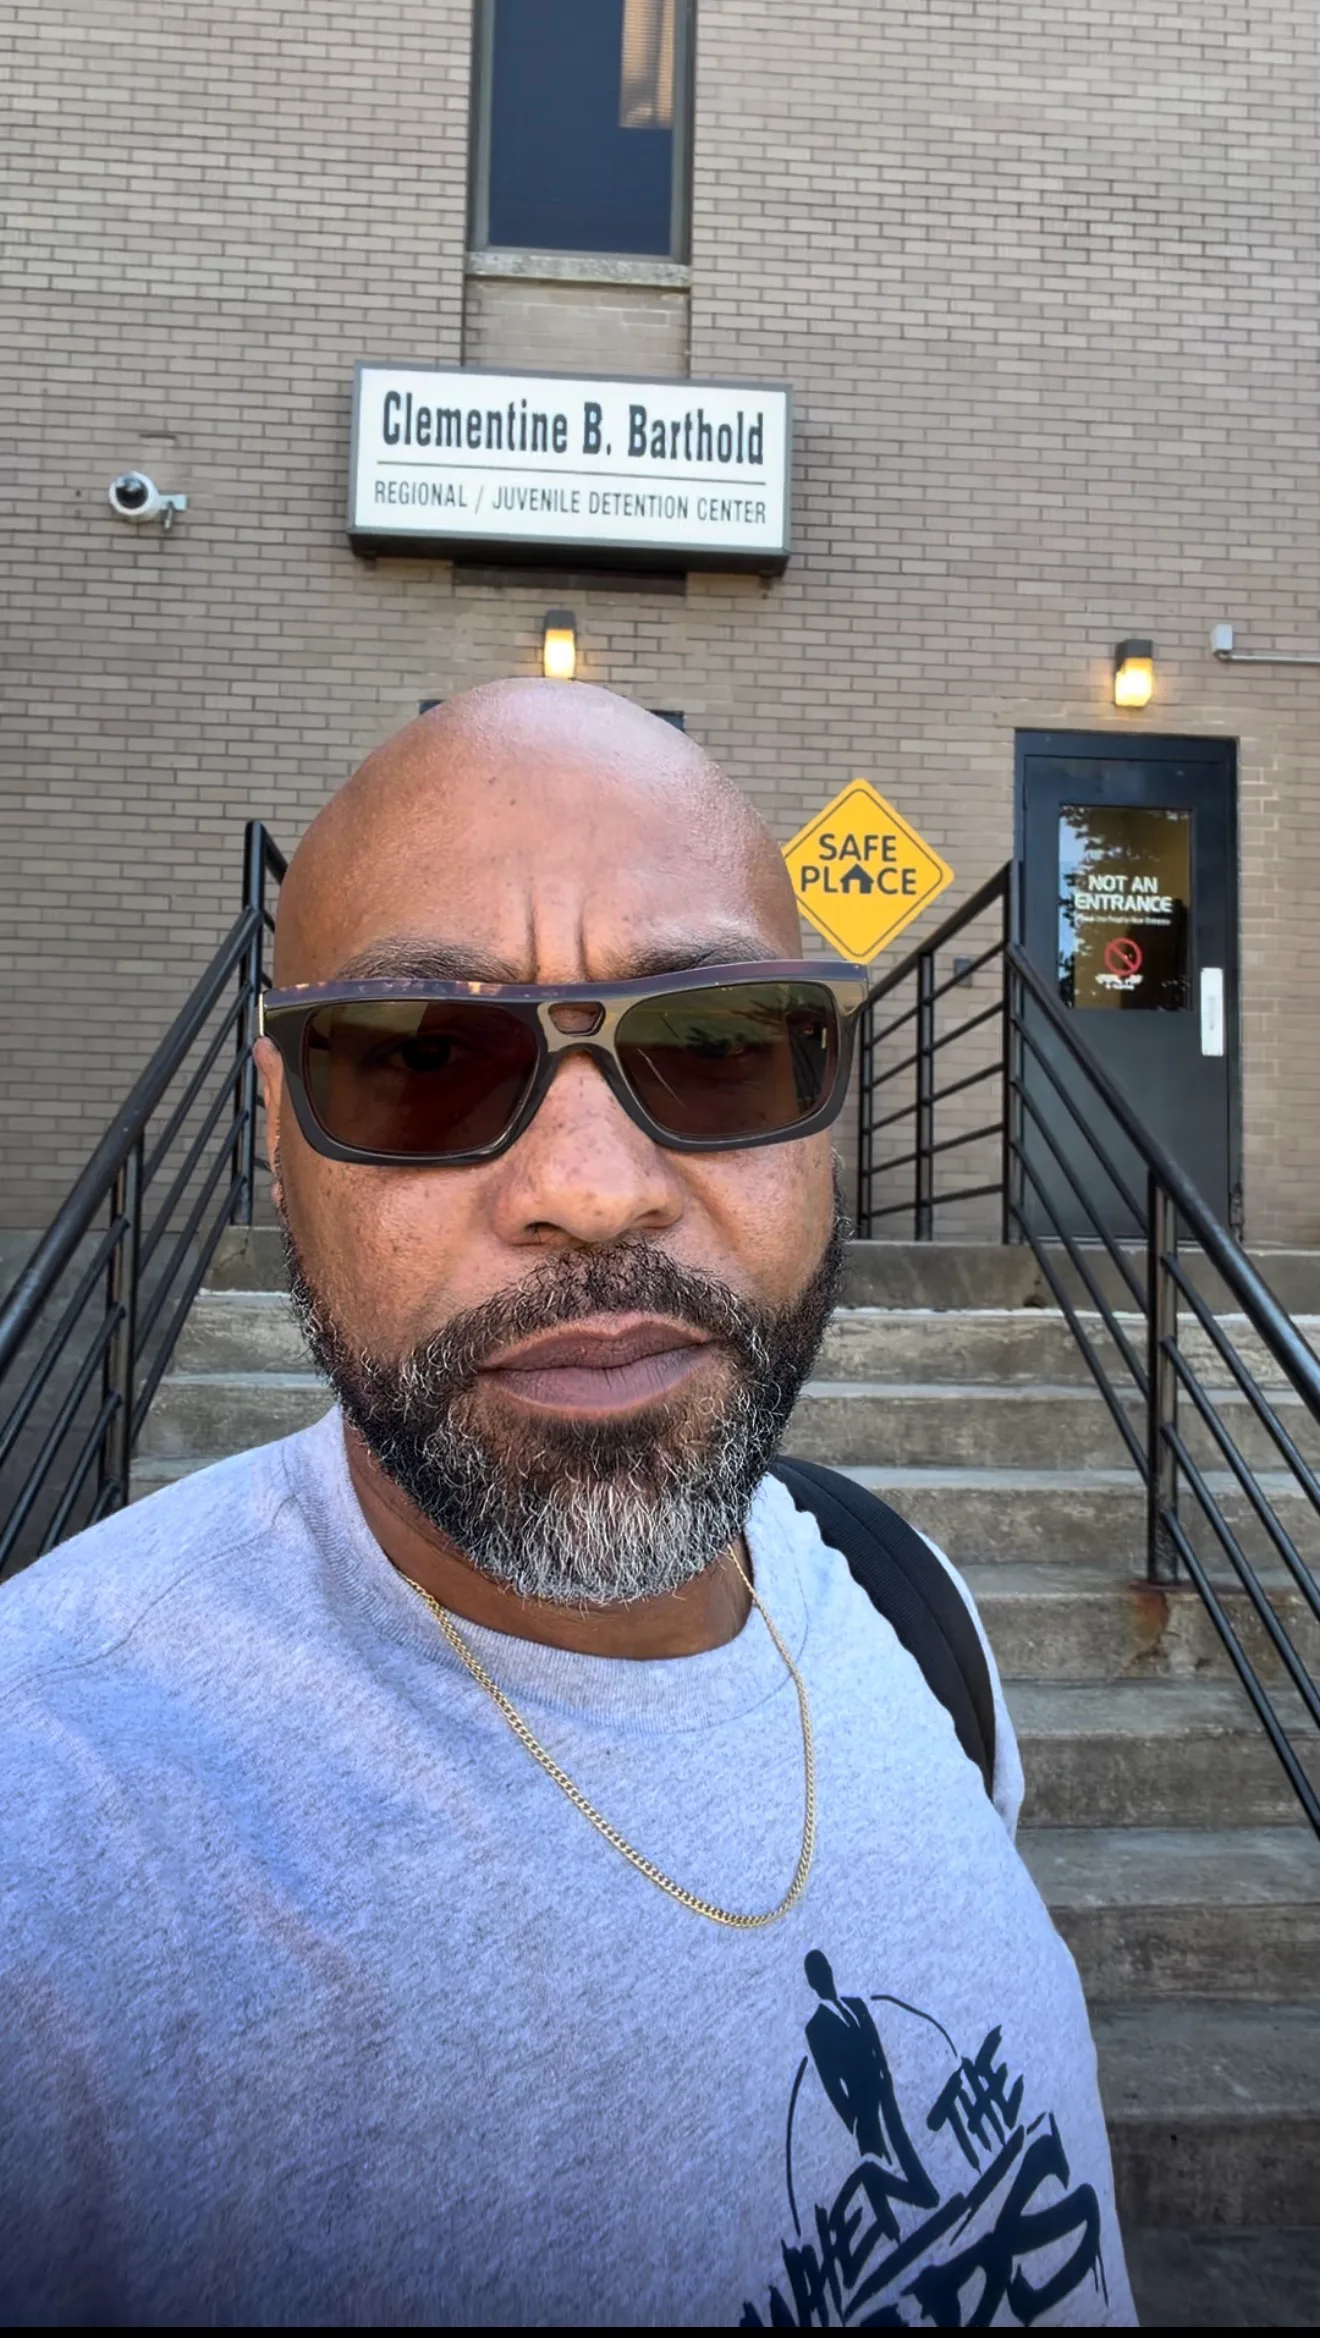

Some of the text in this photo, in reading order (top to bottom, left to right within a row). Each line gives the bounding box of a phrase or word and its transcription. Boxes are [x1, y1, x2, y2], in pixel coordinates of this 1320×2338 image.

[383, 390, 763, 465] Clementine B. Barthold
[374, 480, 766, 524] REGIONAL / JUVENILE DETENTION CENTER
[818, 833, 897, 862] SAFE
[1088, 874, 1158, 894] NOT AN
[1074, 892, 1173, 913] ENTRANCE
[926, 2024, 1025, 2175] THE
